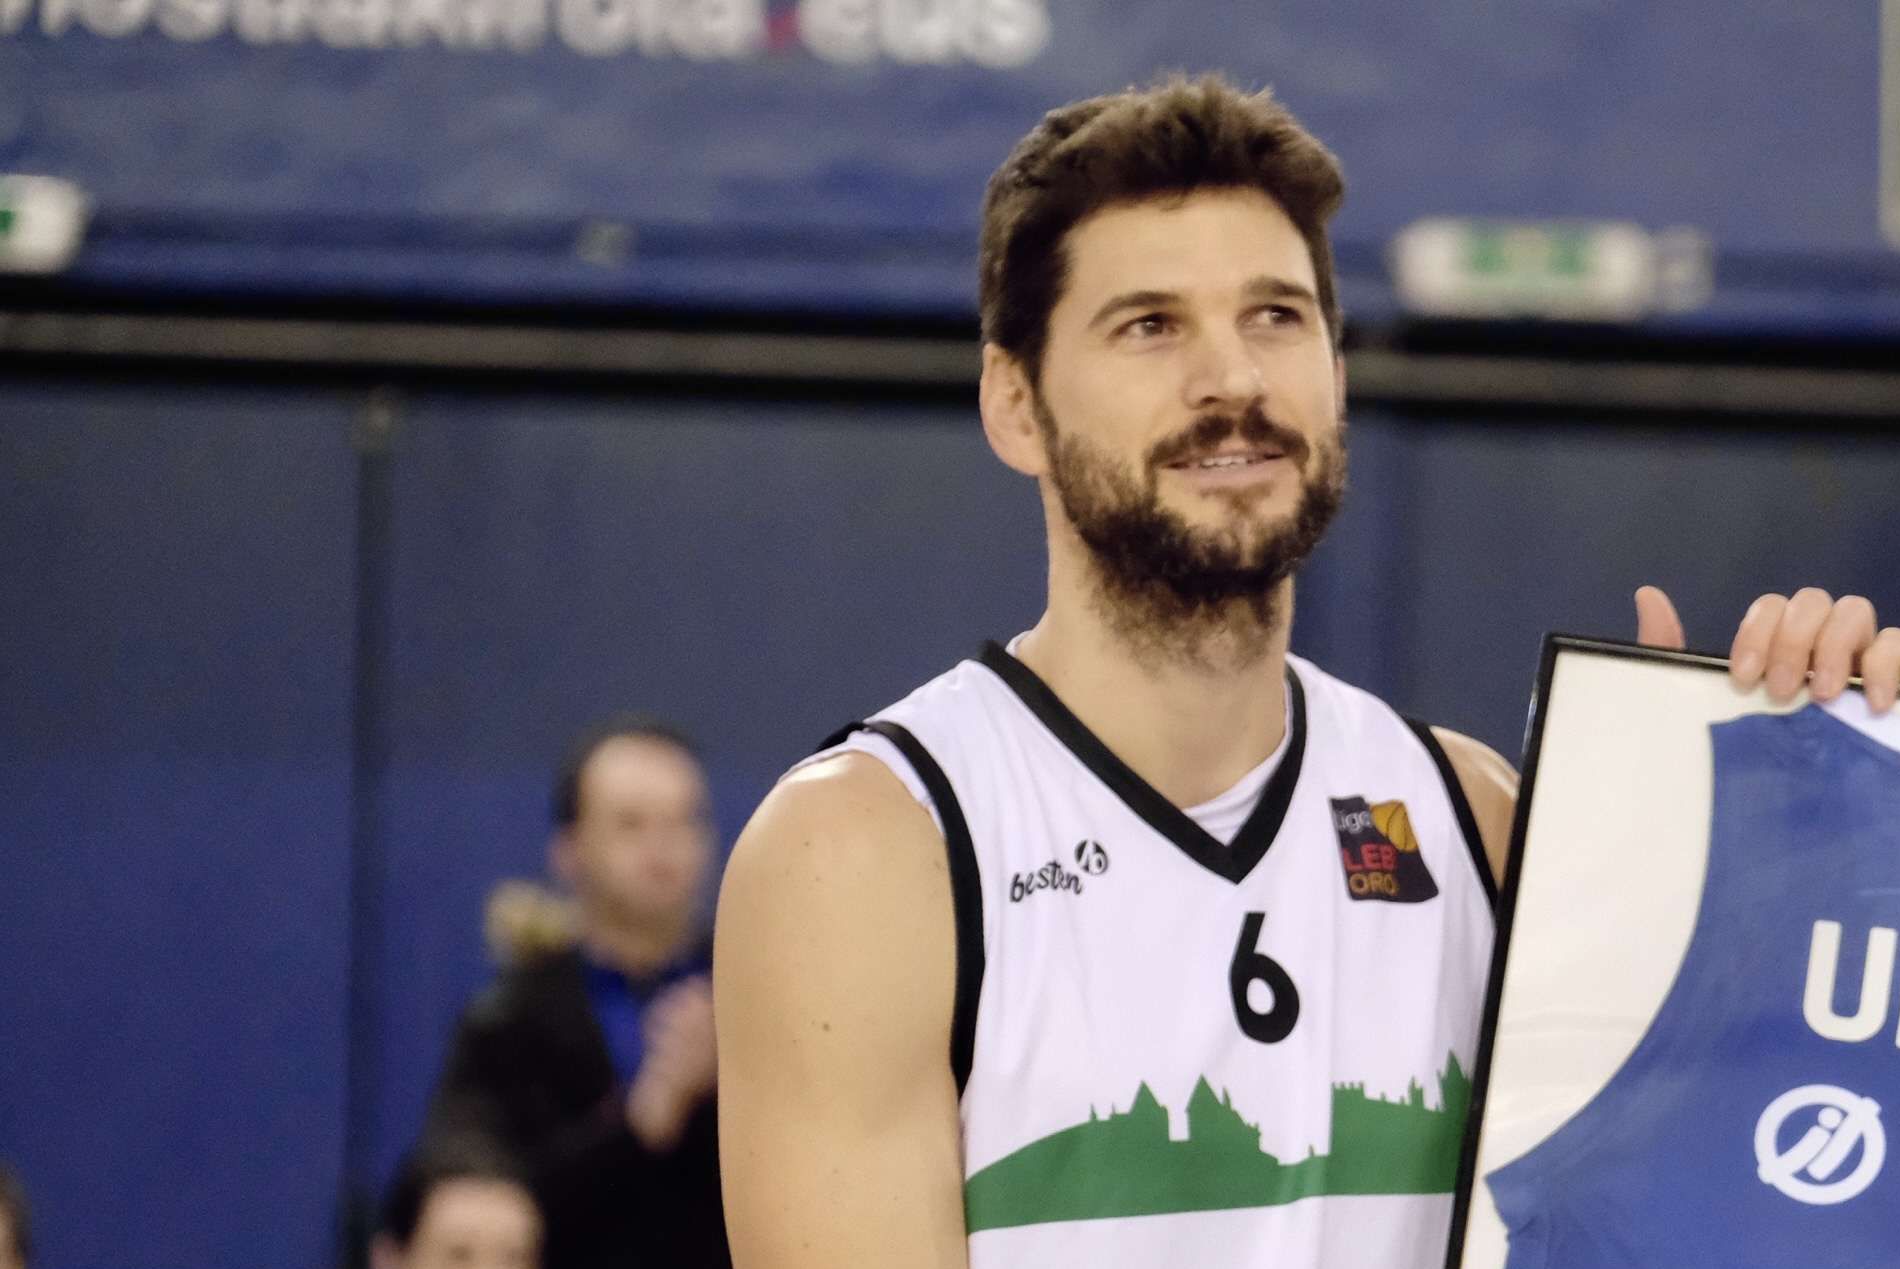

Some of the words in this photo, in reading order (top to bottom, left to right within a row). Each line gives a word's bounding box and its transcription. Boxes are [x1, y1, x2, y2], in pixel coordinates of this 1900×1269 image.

[1343, 843, 1397, 871] LEB
[1349, 871, 1398, 896] ORO
[1230, 912, 1300, 1043] 6
